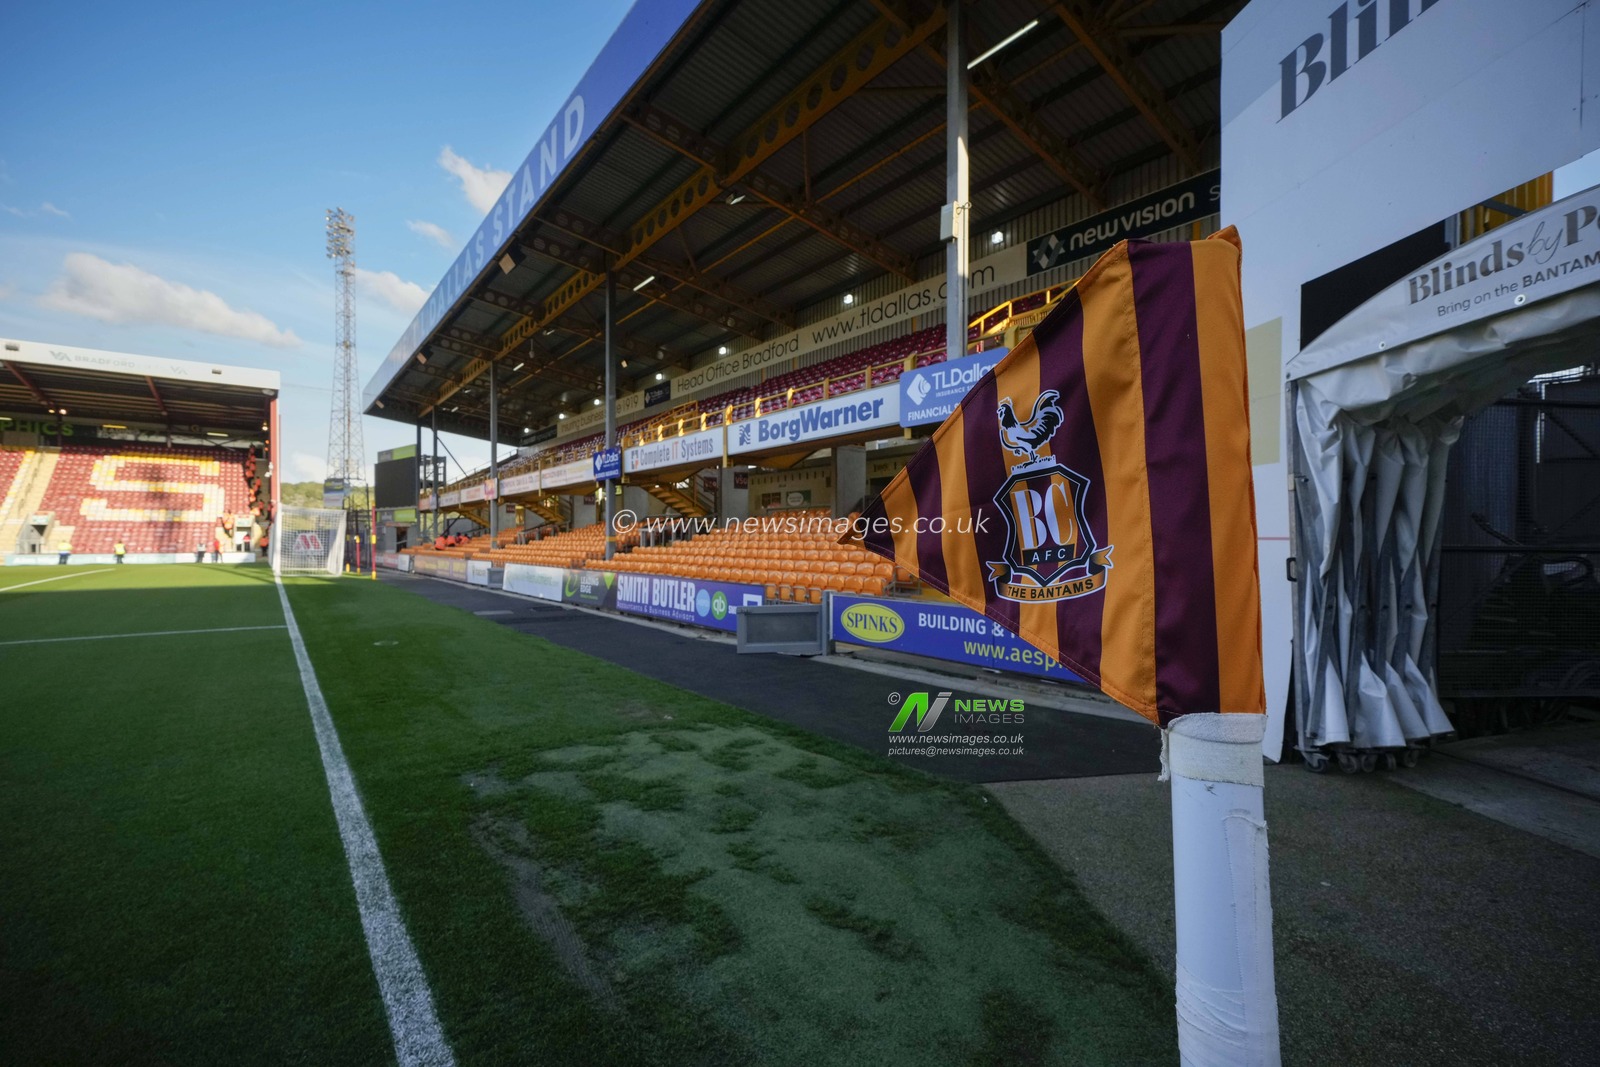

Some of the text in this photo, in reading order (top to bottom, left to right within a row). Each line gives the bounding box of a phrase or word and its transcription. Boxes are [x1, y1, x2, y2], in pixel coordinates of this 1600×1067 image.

[430, 230, 485, 322] DALLAS
[493, 95, 585, 247] STAND
[1408, 240, 1525, 305] Blinds
[1563, 205, 1600, 248] P
[1437, 298, 1471, 317] Bring
[1473, 291, 1491, 304] on
[1494, 280, 1519, 297] the
[677, 371, 704, 392] Head
[706, 360, 740, 382] Office
[742, 334, 799, 369] Bradford
[811, 265, 995, 344] www.tldallas.cm
[931, 363, 998, 391] TLDalla
[935, 386, 966, 398] INSURANCE
[757, 397, 884, 443] BorgWarner
[907, 404, 951, 421] FINANCIAL
[640, 438, 714, 468] Complete IT Systems
[1011, 482, 1074, 550] BC
[580, 585, 592, 594] EDGE
[616, 574, 696, 613] SMITH BUTLER
[1007, 579, 1095, 599] THE BANTAMS
[672, 610, 695, 622] Advisors
[846, 611, 898, 634] SPINKS
[918, 612, 1005, 637] BUILDING &
[963, 641, 1064, 671] www.aesp
